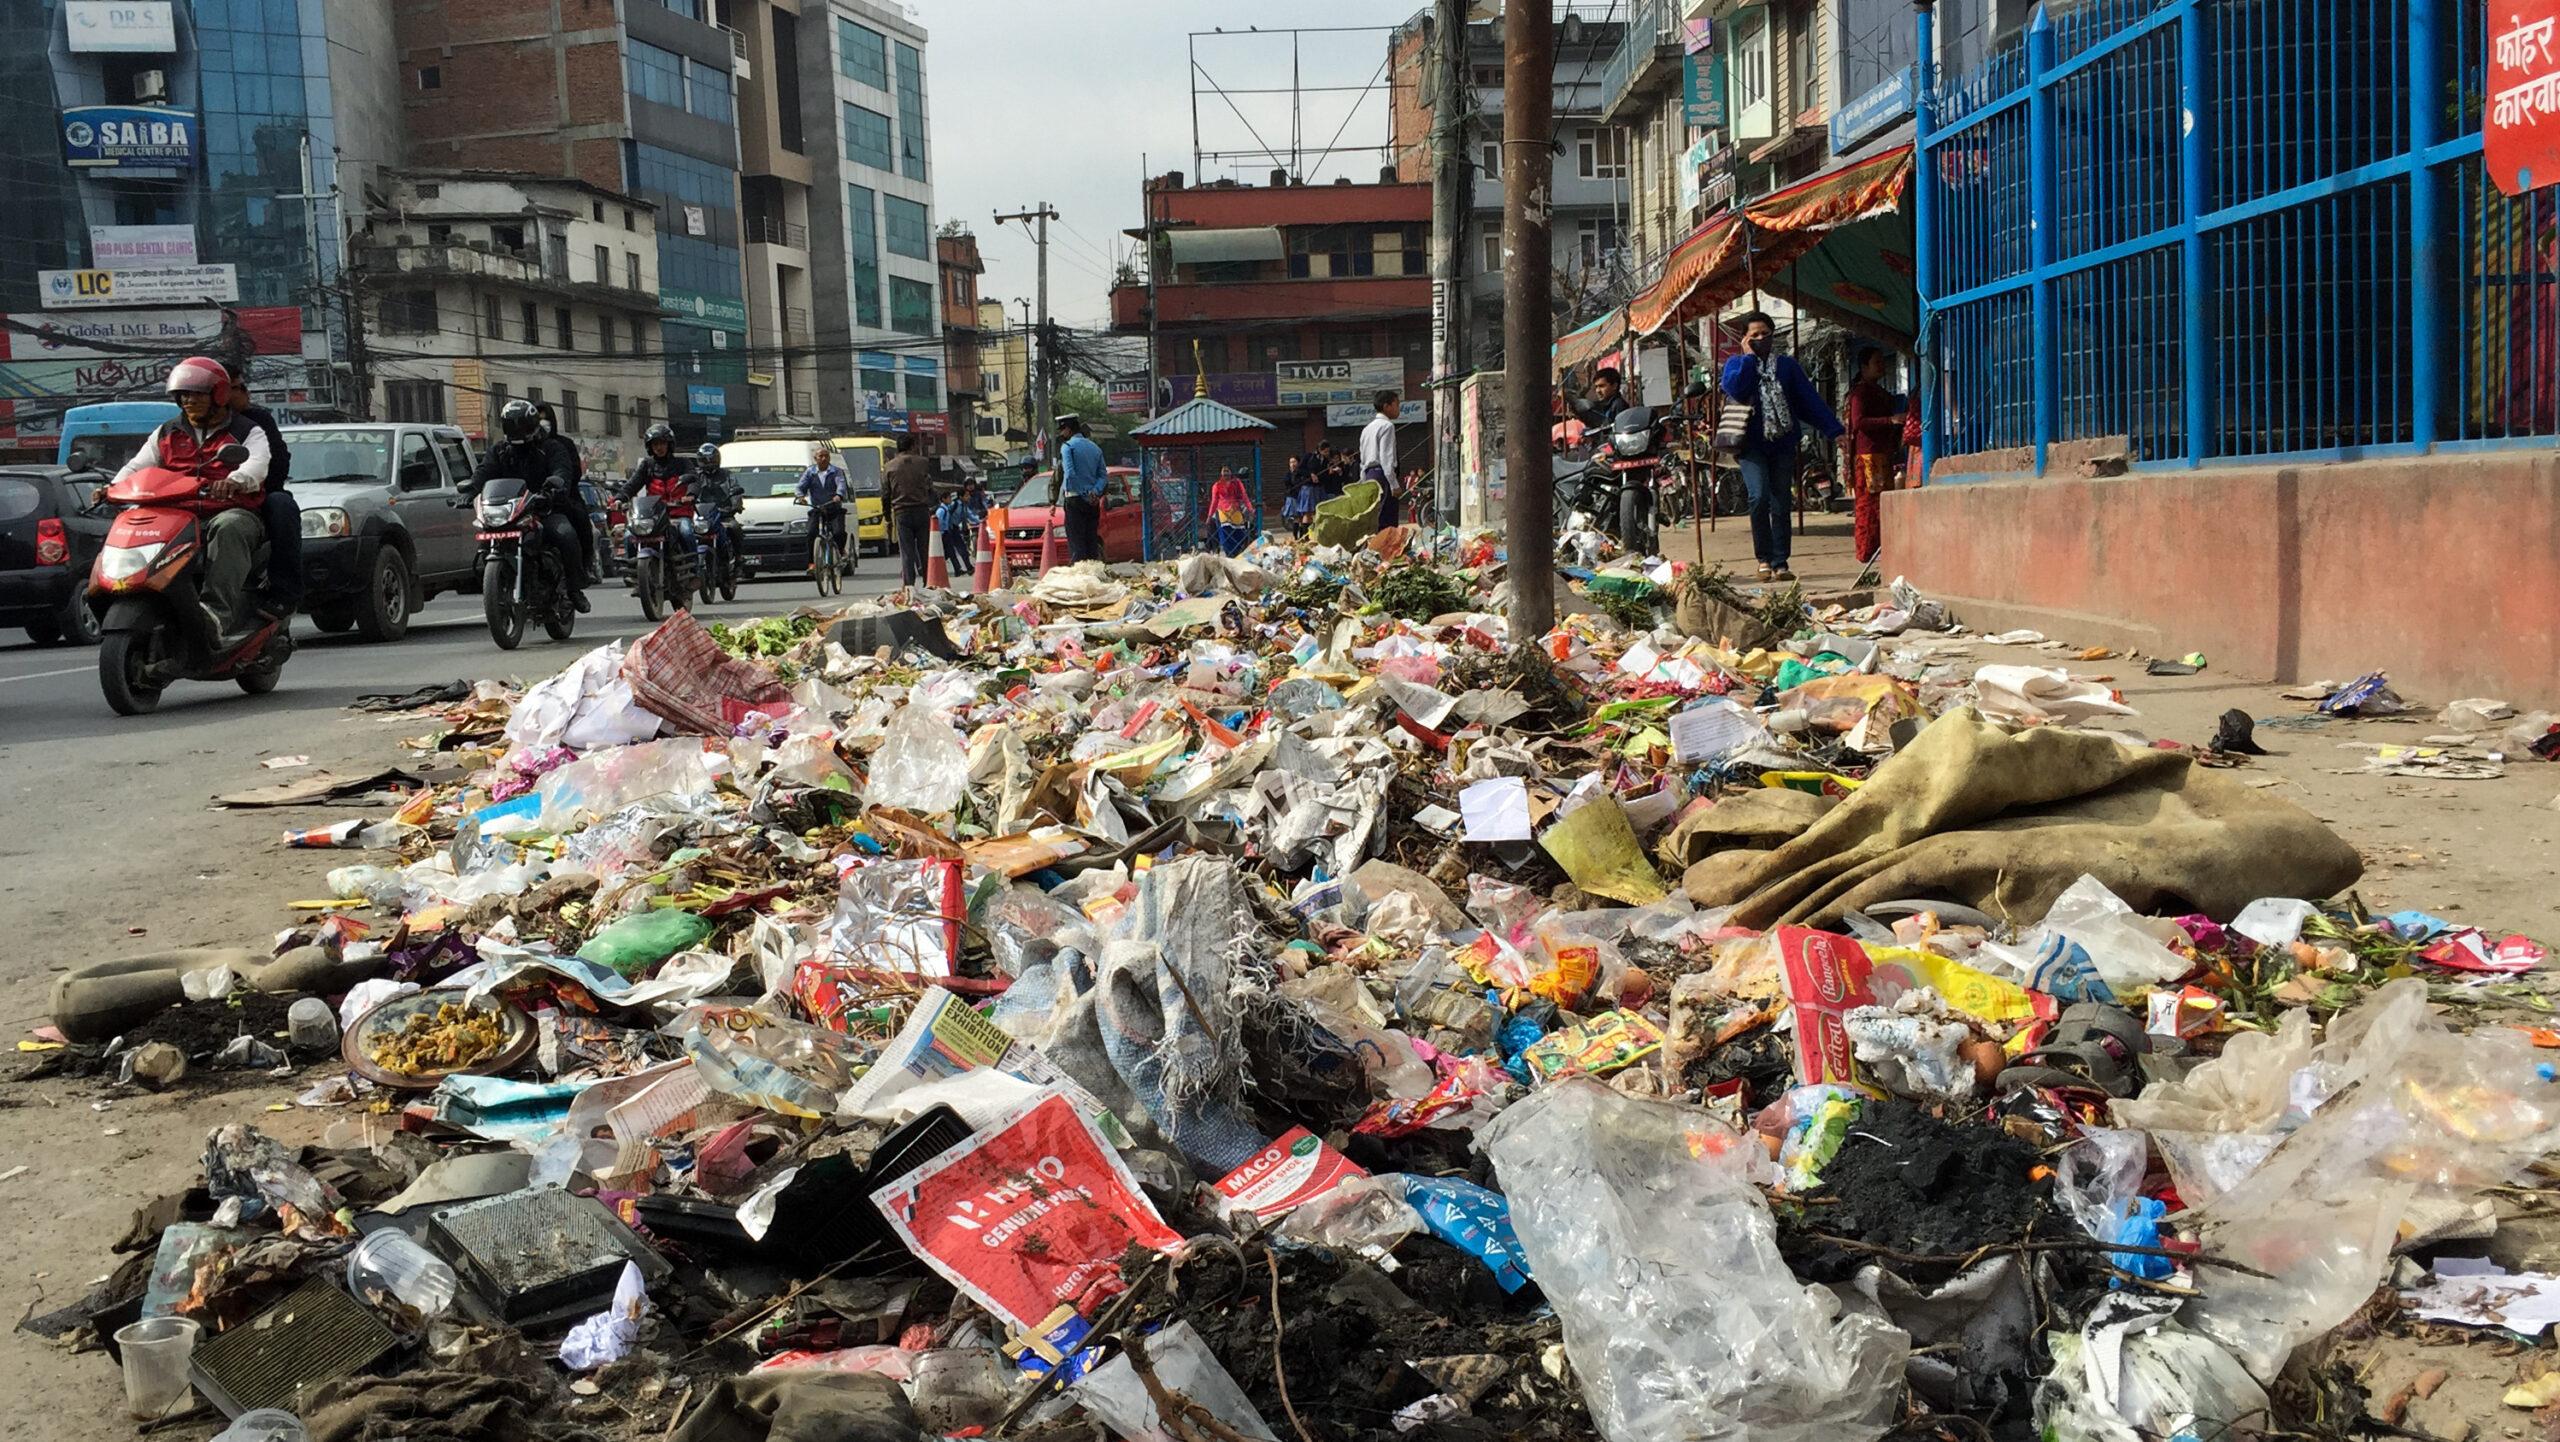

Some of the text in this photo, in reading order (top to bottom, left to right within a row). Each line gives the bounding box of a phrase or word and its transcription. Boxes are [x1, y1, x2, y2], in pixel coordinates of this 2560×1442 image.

[2496, 14, 2555, 75] फोहर
[104, 146, 135, 156] MEDICAL
[136, 147, 163, 156] CENTRE
[136, 242, 165, 254] DENTAL
[166, 241, 193, 254] CLINIC
[76, 272, 111, 295] LIC
[67, 323, 196, 337] Global IME Bank
[1114, 382, 1145, 393] IME
[1291, 365, 1349, 380] IME
[944, 1007, 1003, 1055] EXHIBITION
[950, 998, 1009, 1046] EDUCATION
[1226, 1148, 1282, 1191] MACO
[1244, 1158, 1303, 1201] BRAKE SHOE
[981, 1198, 1051, 1248] GENUINE
[1051, 1268, 1084, 1301] Hero
